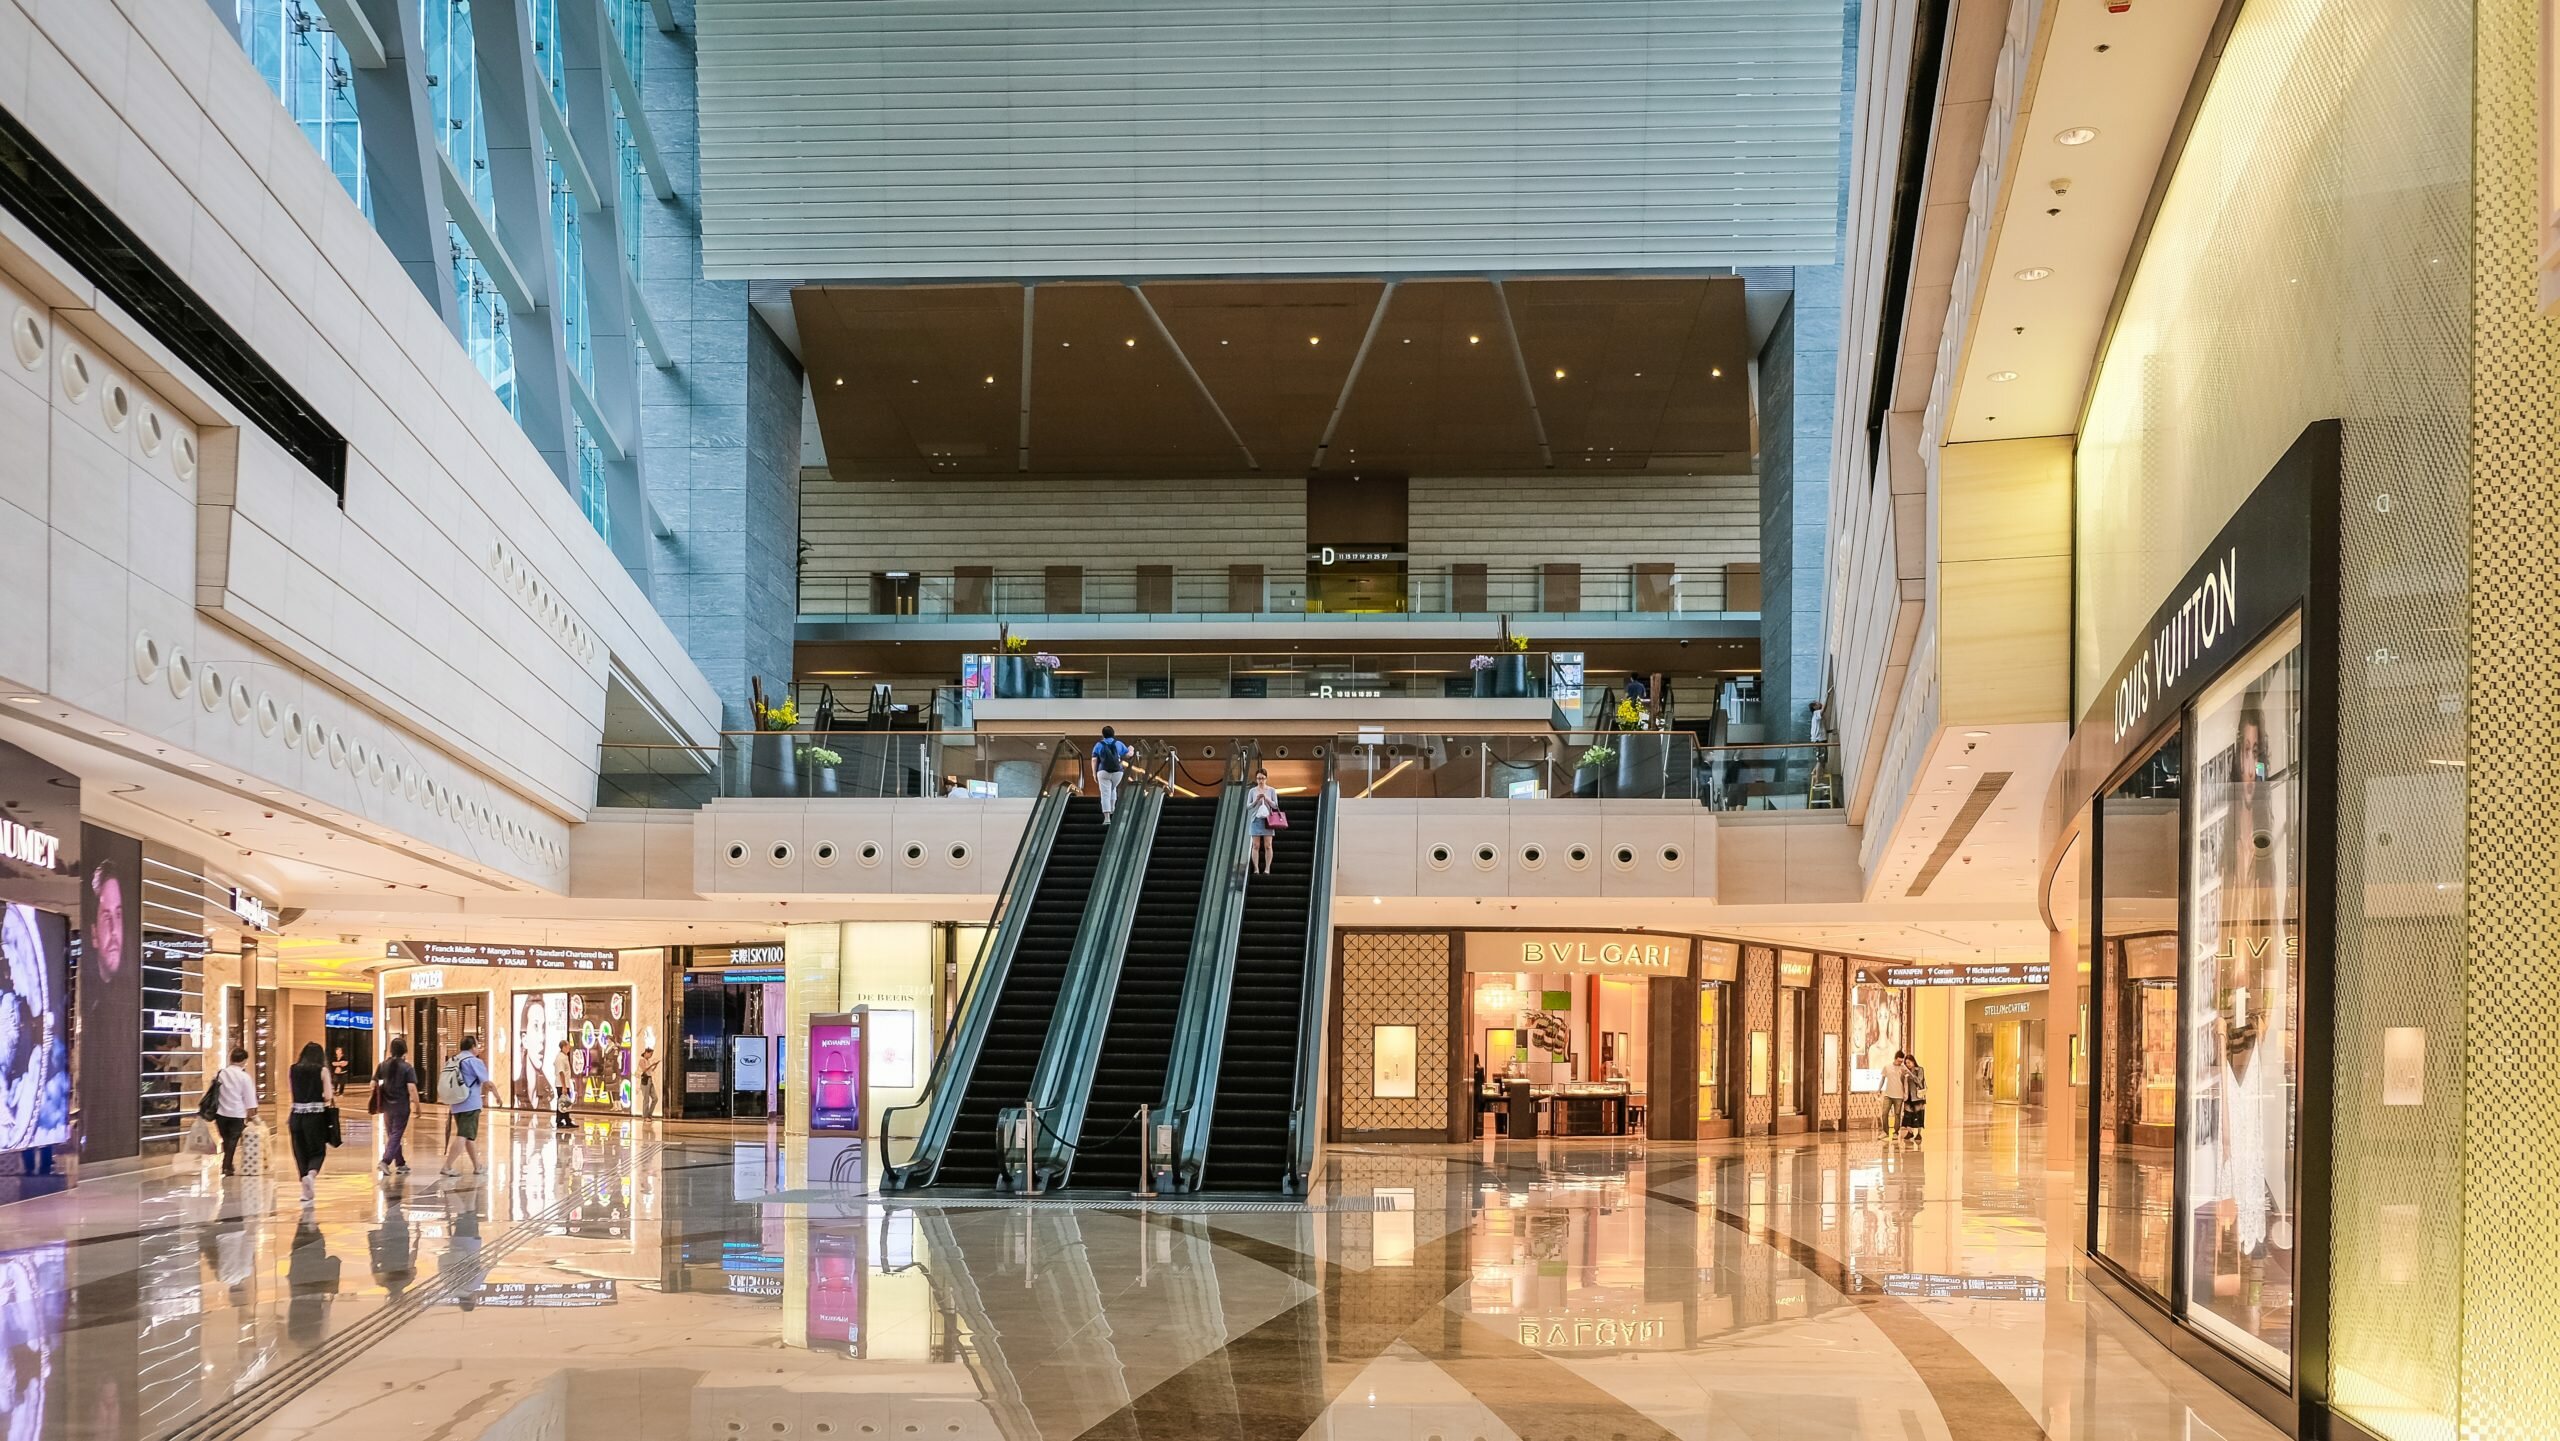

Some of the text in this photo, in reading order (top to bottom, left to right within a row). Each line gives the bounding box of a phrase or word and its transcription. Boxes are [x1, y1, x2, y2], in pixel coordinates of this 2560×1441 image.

[1322, 547, 1335, 566] D
[2114, 546, 2236, 744] LOUIS VUITTON
[431, 945, 454, 953] Franck
[487, 947, 511, 956] Mango
[536, 949, 614, 959] Standard Chartered Bank
[751, 946, 784, 963] SKY100
[1523, 943, 1670, 967] BVLGARI
[431, 955, 451, 963] Dolce
[458, 956, 489, 965] Gabbana
[504, 958, 528, 966] TASAKI
[542, 959, 565, 968] Corum
[1893, 968, 1923, 976] KWANPEN
[1971, 976, 2021, 984] Stella McCartney
[858, 993, 915, 1001] DE BEERS
